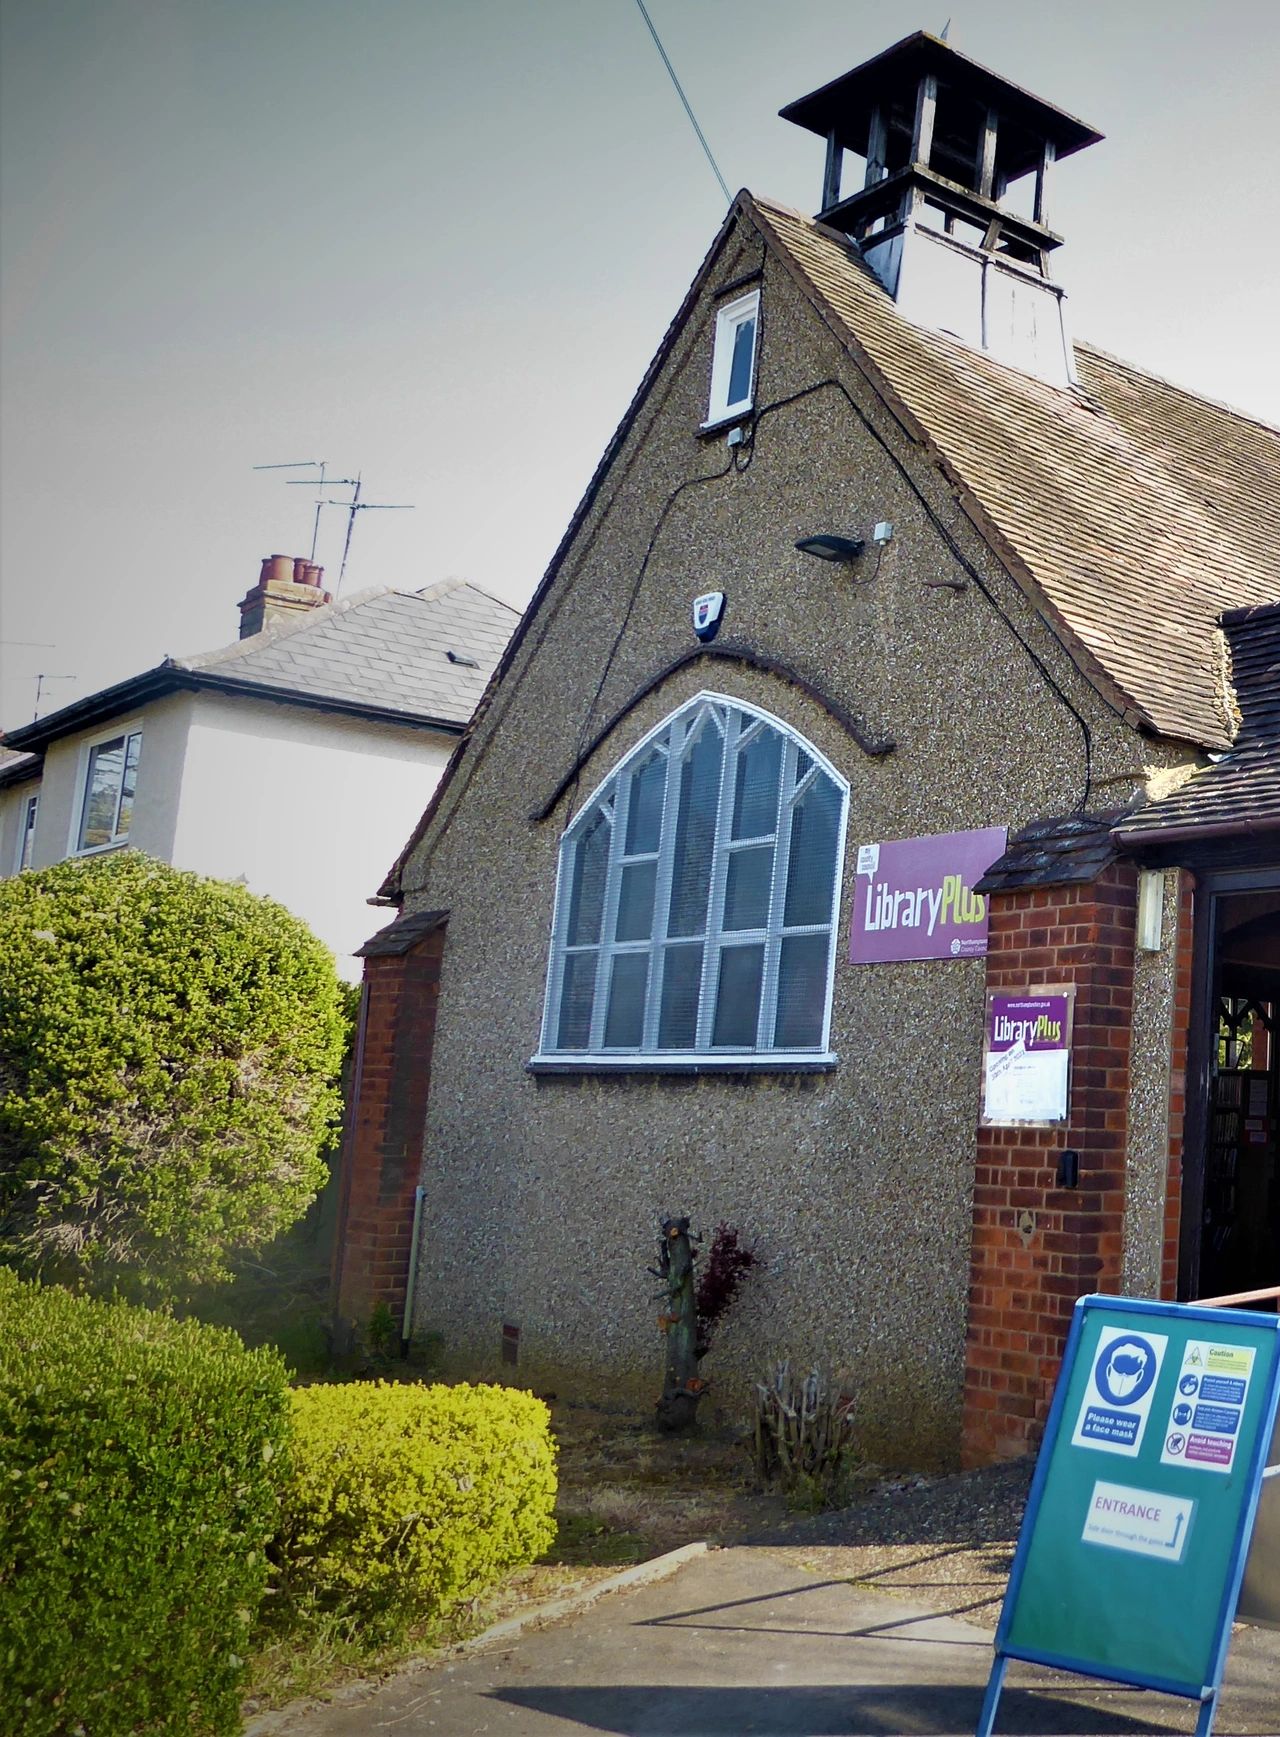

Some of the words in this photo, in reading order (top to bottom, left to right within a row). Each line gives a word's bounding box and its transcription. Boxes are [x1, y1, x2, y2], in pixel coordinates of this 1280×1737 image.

[994, 1014, 1061, 1047] LibraryPlus
[1209, 1349, 1234, 1358] Caution
[1087, 1412, 1115, 1425] Please
[1116, 1419, 1137, 1429] wear
[1092, 1423, 1110, 1434] face
[1111, 1428, 1134, 1439] mask
[1095, 1496, 1162, 1521] ENTRANCE
